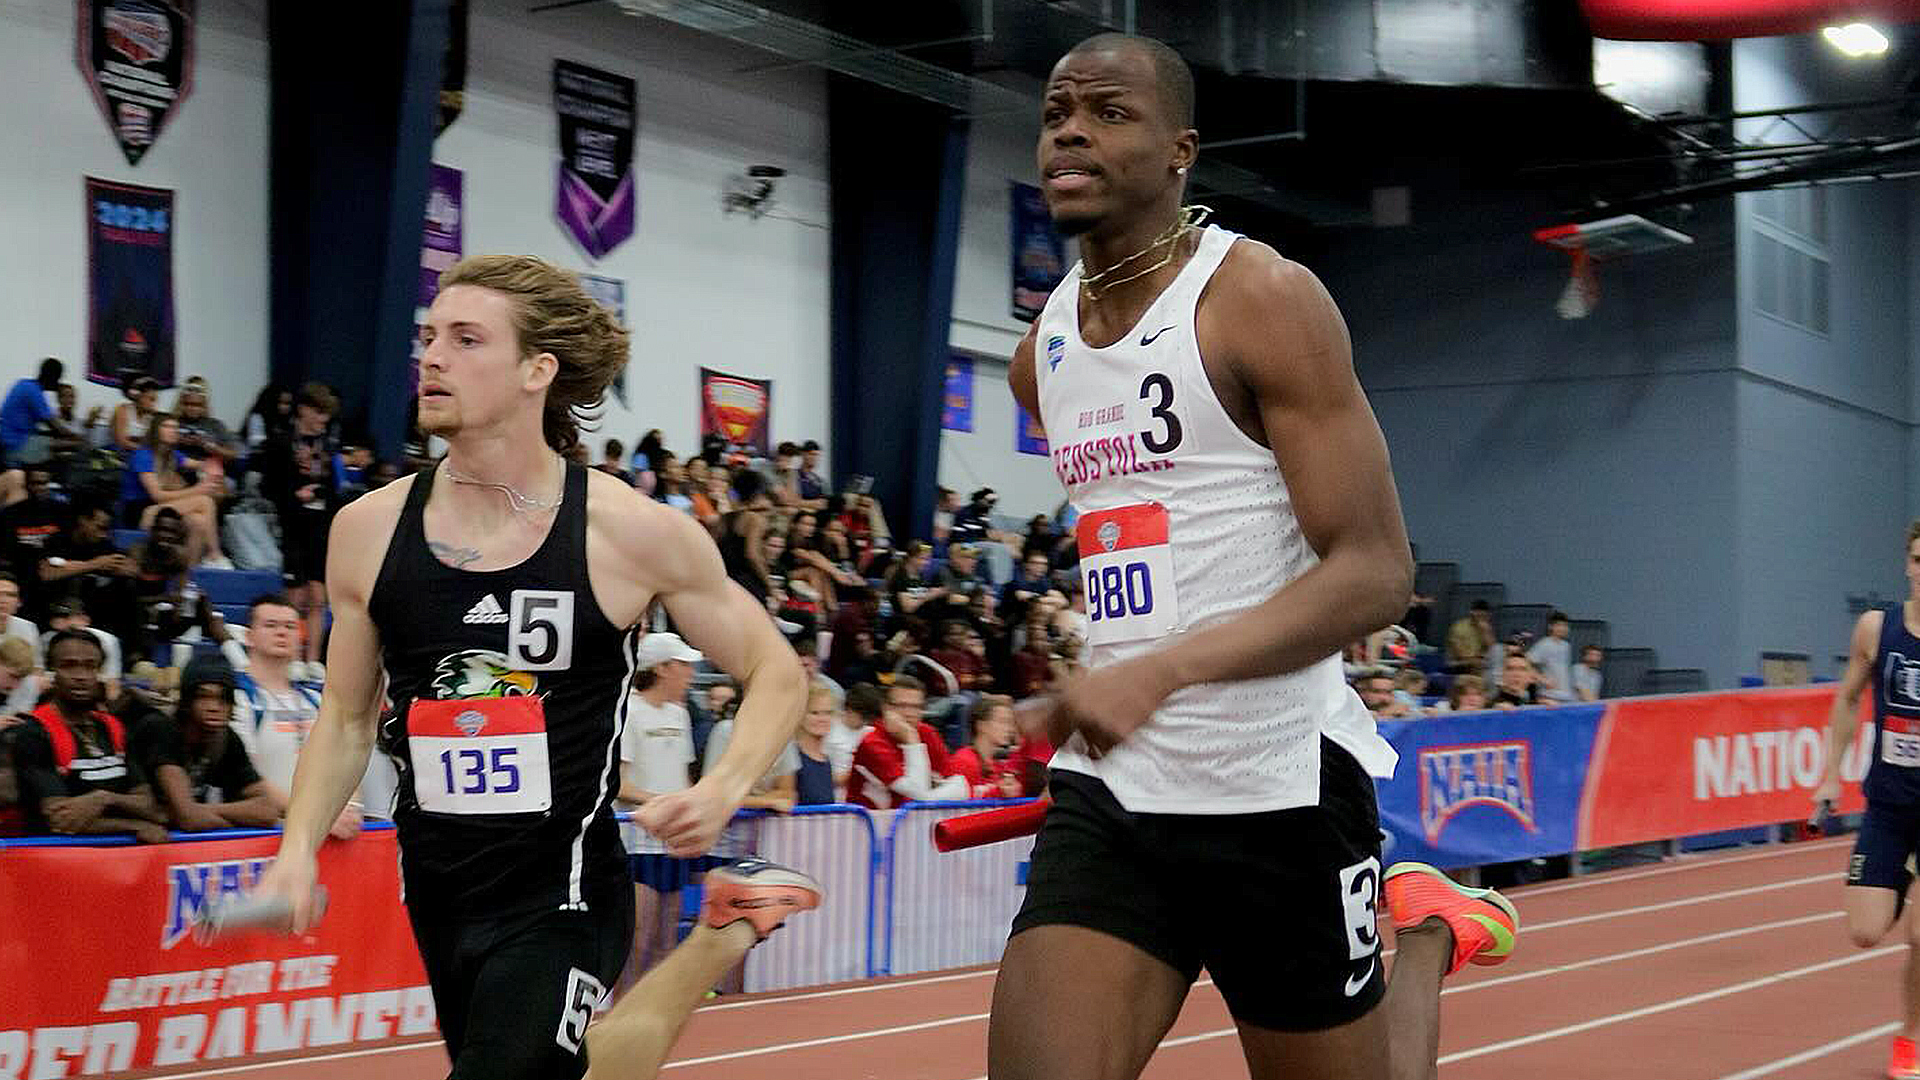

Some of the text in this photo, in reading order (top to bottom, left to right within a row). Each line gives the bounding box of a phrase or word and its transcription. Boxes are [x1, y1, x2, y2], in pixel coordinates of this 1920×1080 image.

[1140, 373, 1183, 454] 3
[462, 613, 509, 624] adidas
[1088, 561, 1153, 622] 980
[518, 597, 559, 664] 5
[440, 747, 520, 794] 135
[1350, 868, 1378, 945] 3
[99, 954, 338, 1012] BATTLE FOR THE
[565, 978, 599, 1047] 5
[152, 985, 440, 1067] BANNER
